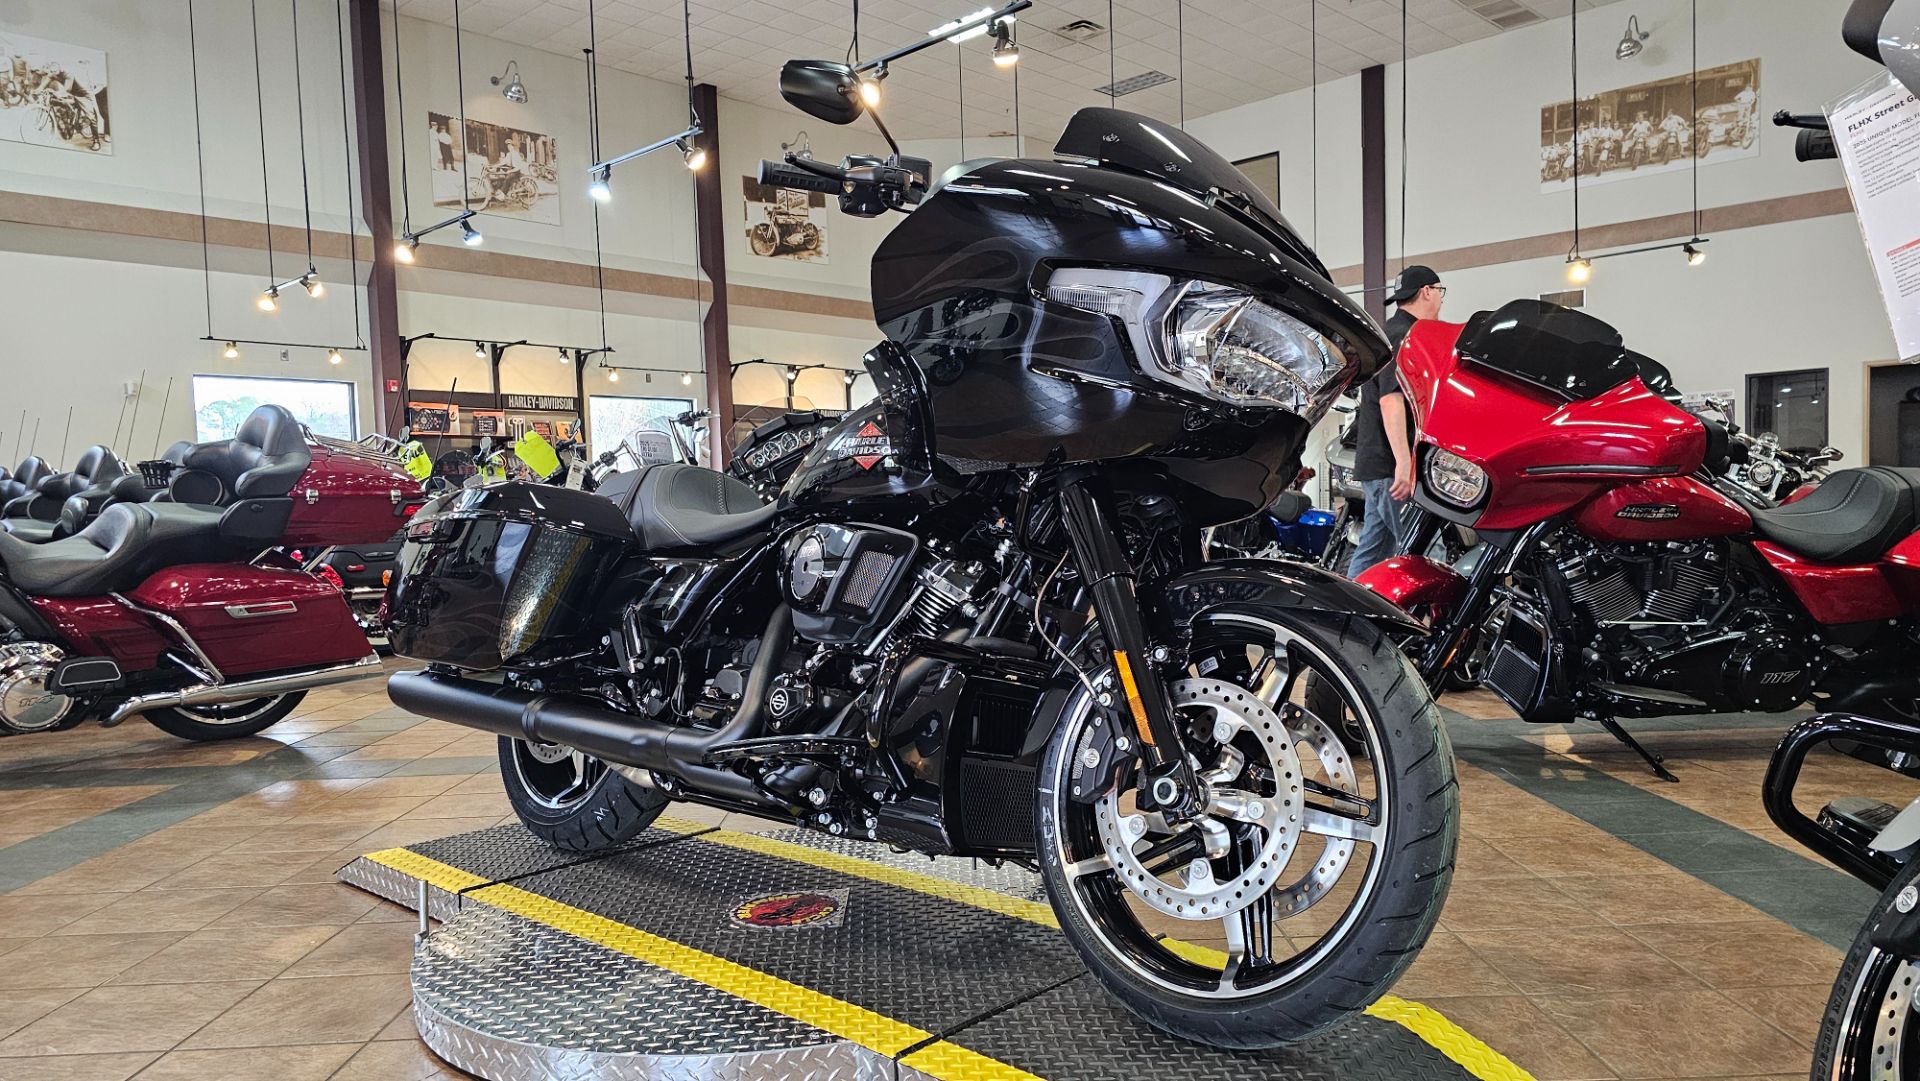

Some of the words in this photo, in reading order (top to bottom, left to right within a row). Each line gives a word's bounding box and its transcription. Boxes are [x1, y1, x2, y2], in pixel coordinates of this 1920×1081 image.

[1848, 115, 1873, 133] FLHX
[1874, 100, 1905, 120] Street
[1867, 127, 1890, 142] UNIQUE
[1891, 116, 1914, 130] MODEL
[508, 395, 574, 410] HARLEY-DAVIDSON
[1617, 511, 1680, 519] DAVIDSON
[1760, 670, 1801, 684] 117
